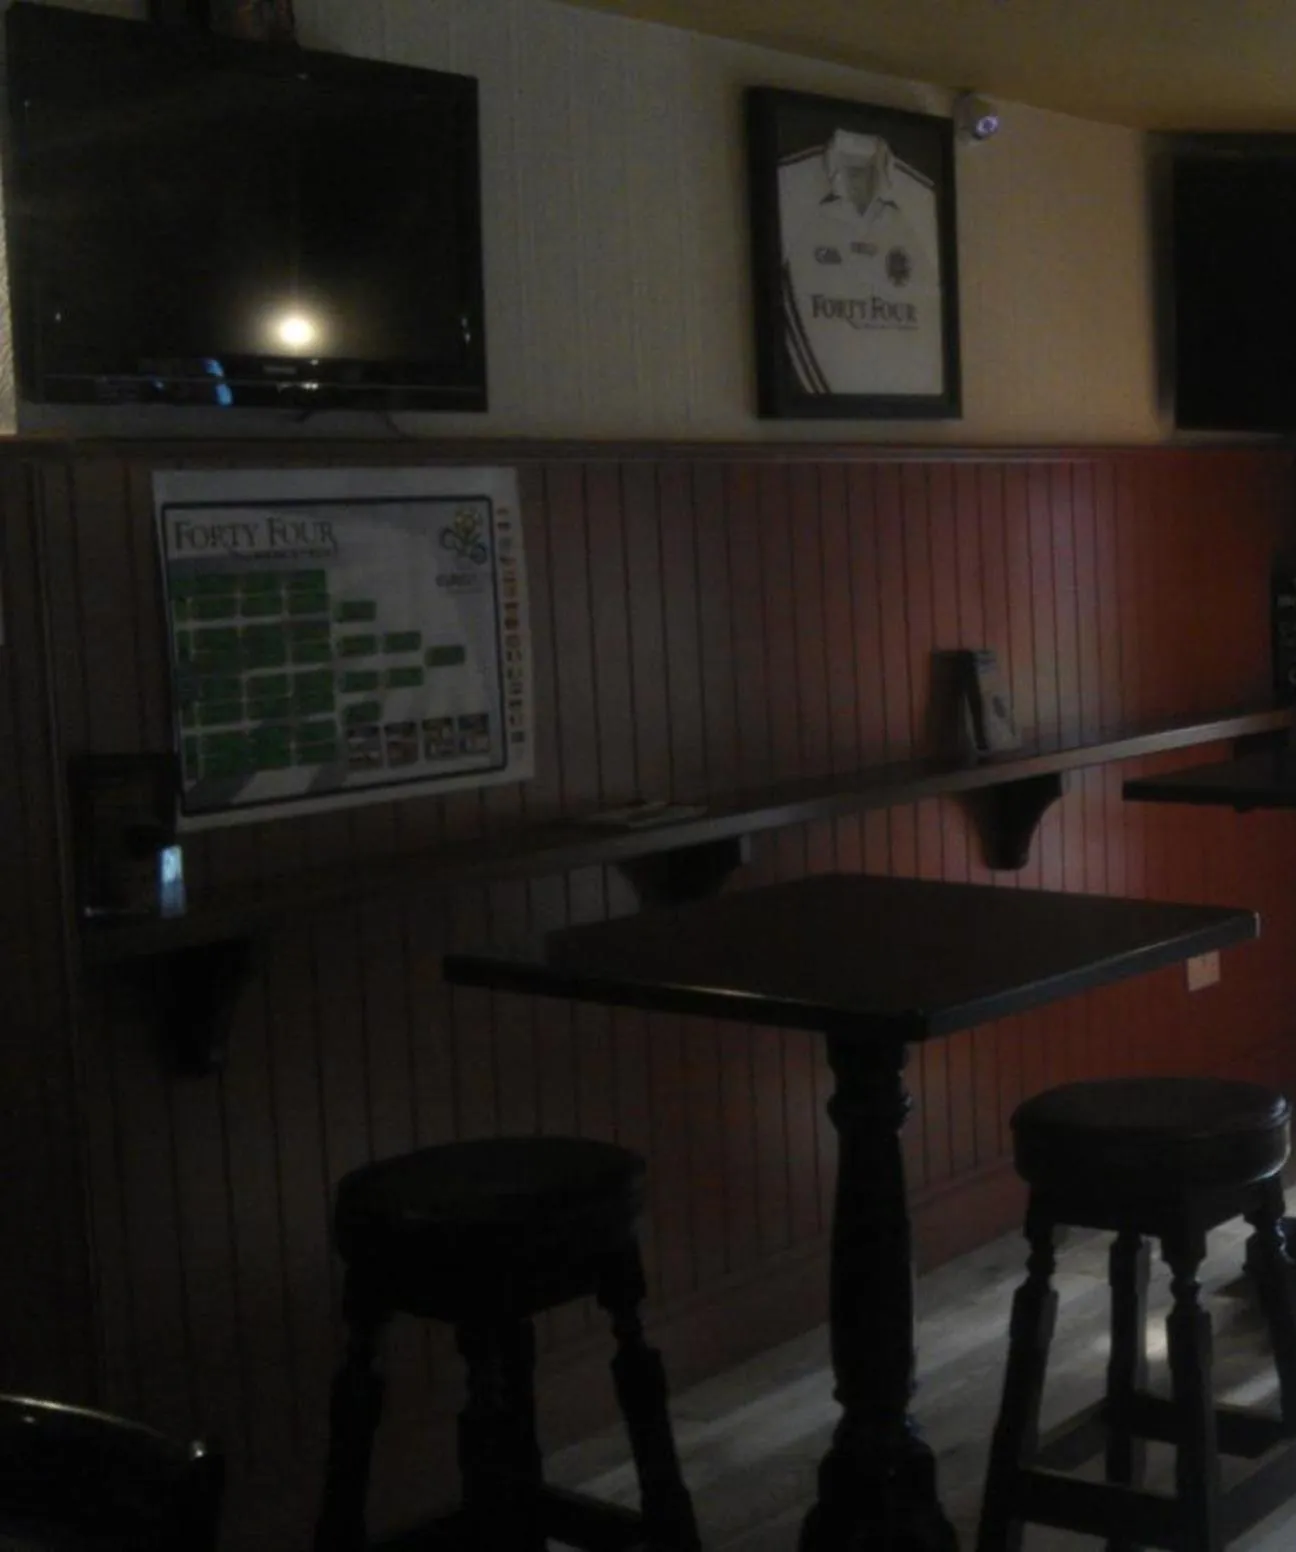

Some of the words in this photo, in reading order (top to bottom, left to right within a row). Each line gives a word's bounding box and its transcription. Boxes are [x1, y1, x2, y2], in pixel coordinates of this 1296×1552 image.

[811, 294, 867, 319] FORTY
[871, 295, 918, 322] FOUR
[174, 520, 259, 551] FORTY
[265, 515, 338, 550] FOUR
